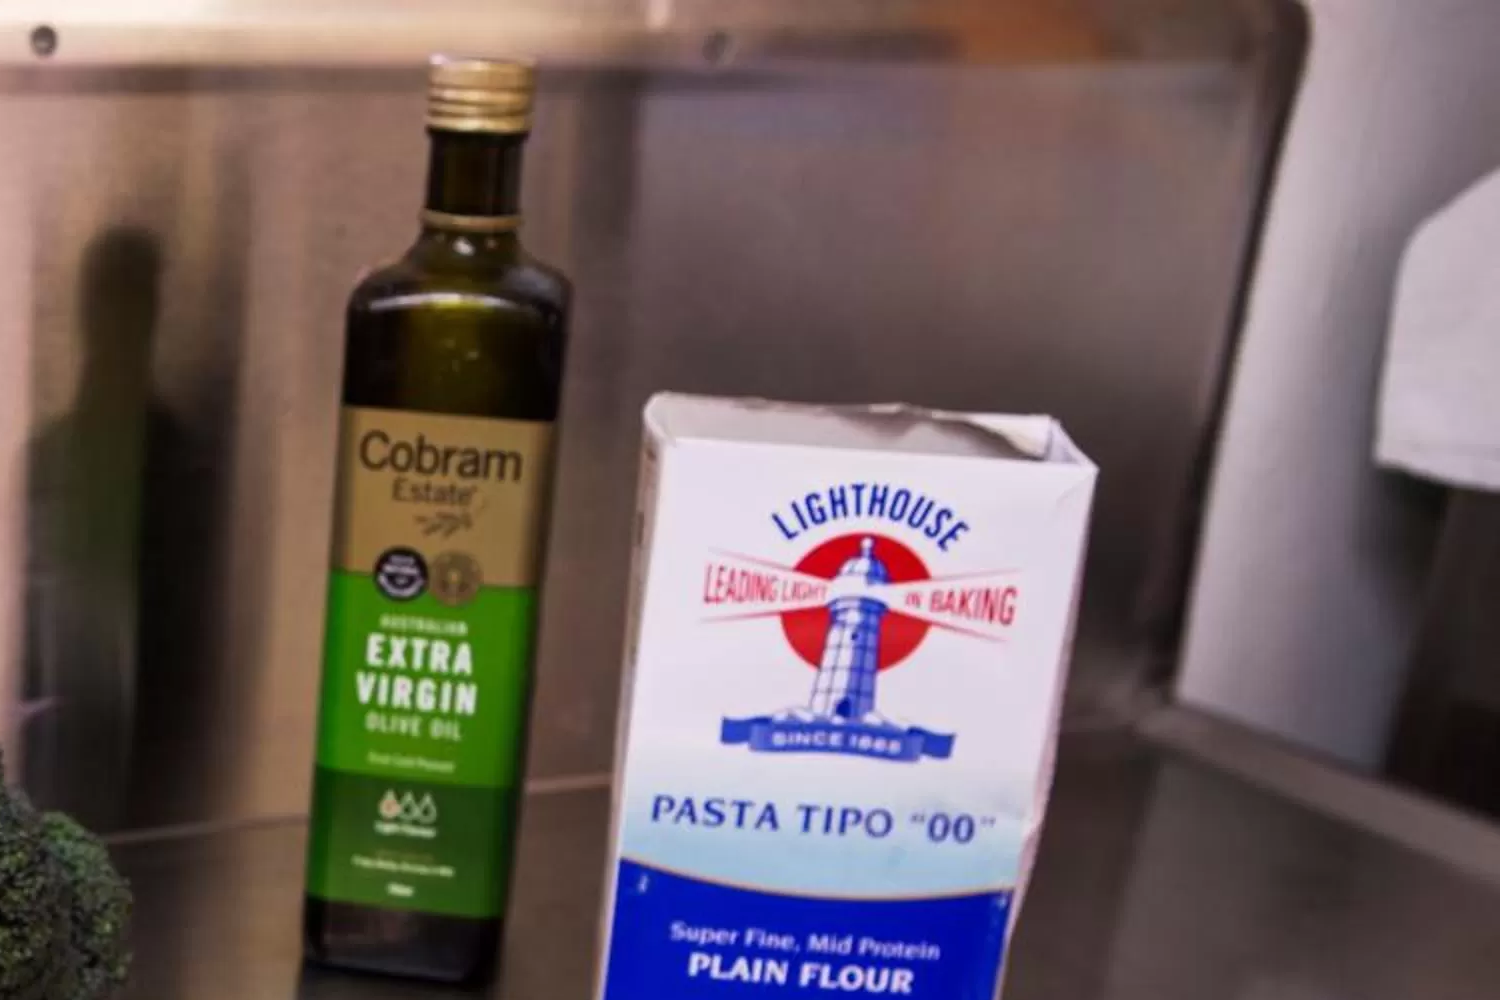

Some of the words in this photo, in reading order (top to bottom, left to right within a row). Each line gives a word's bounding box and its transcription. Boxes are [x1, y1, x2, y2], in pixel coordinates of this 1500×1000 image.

[359, 429, 522, 483] Cobram
[391, 477, 473, 508] Estate
[772, 482, 970, 553] LIGHTHOUSE
[703, 563, 778, 605] LEADING
[930, 583, 1018, 627] BAKING
[365, 632, 474, 675] EXTRA
[356, 671, 478, 715] VIRGIN
[364, 711, 422, 738] OLIVE
[430, 717, 462, 741] OIL
[771, 730, 845, 747] SINCE
[650, 794, 780, 833] PASTA
[795, 804, 895, 839] TIPO
[670, 920, 739, 947] Super
[743, 927, 801, 952] Fine,
[806, 933, 854, 955] Mid
[857, 936, 941, 961] Protein
[687, 951, 790, 986] PLAIN
[798, 962, 915, 995] FLOUR
